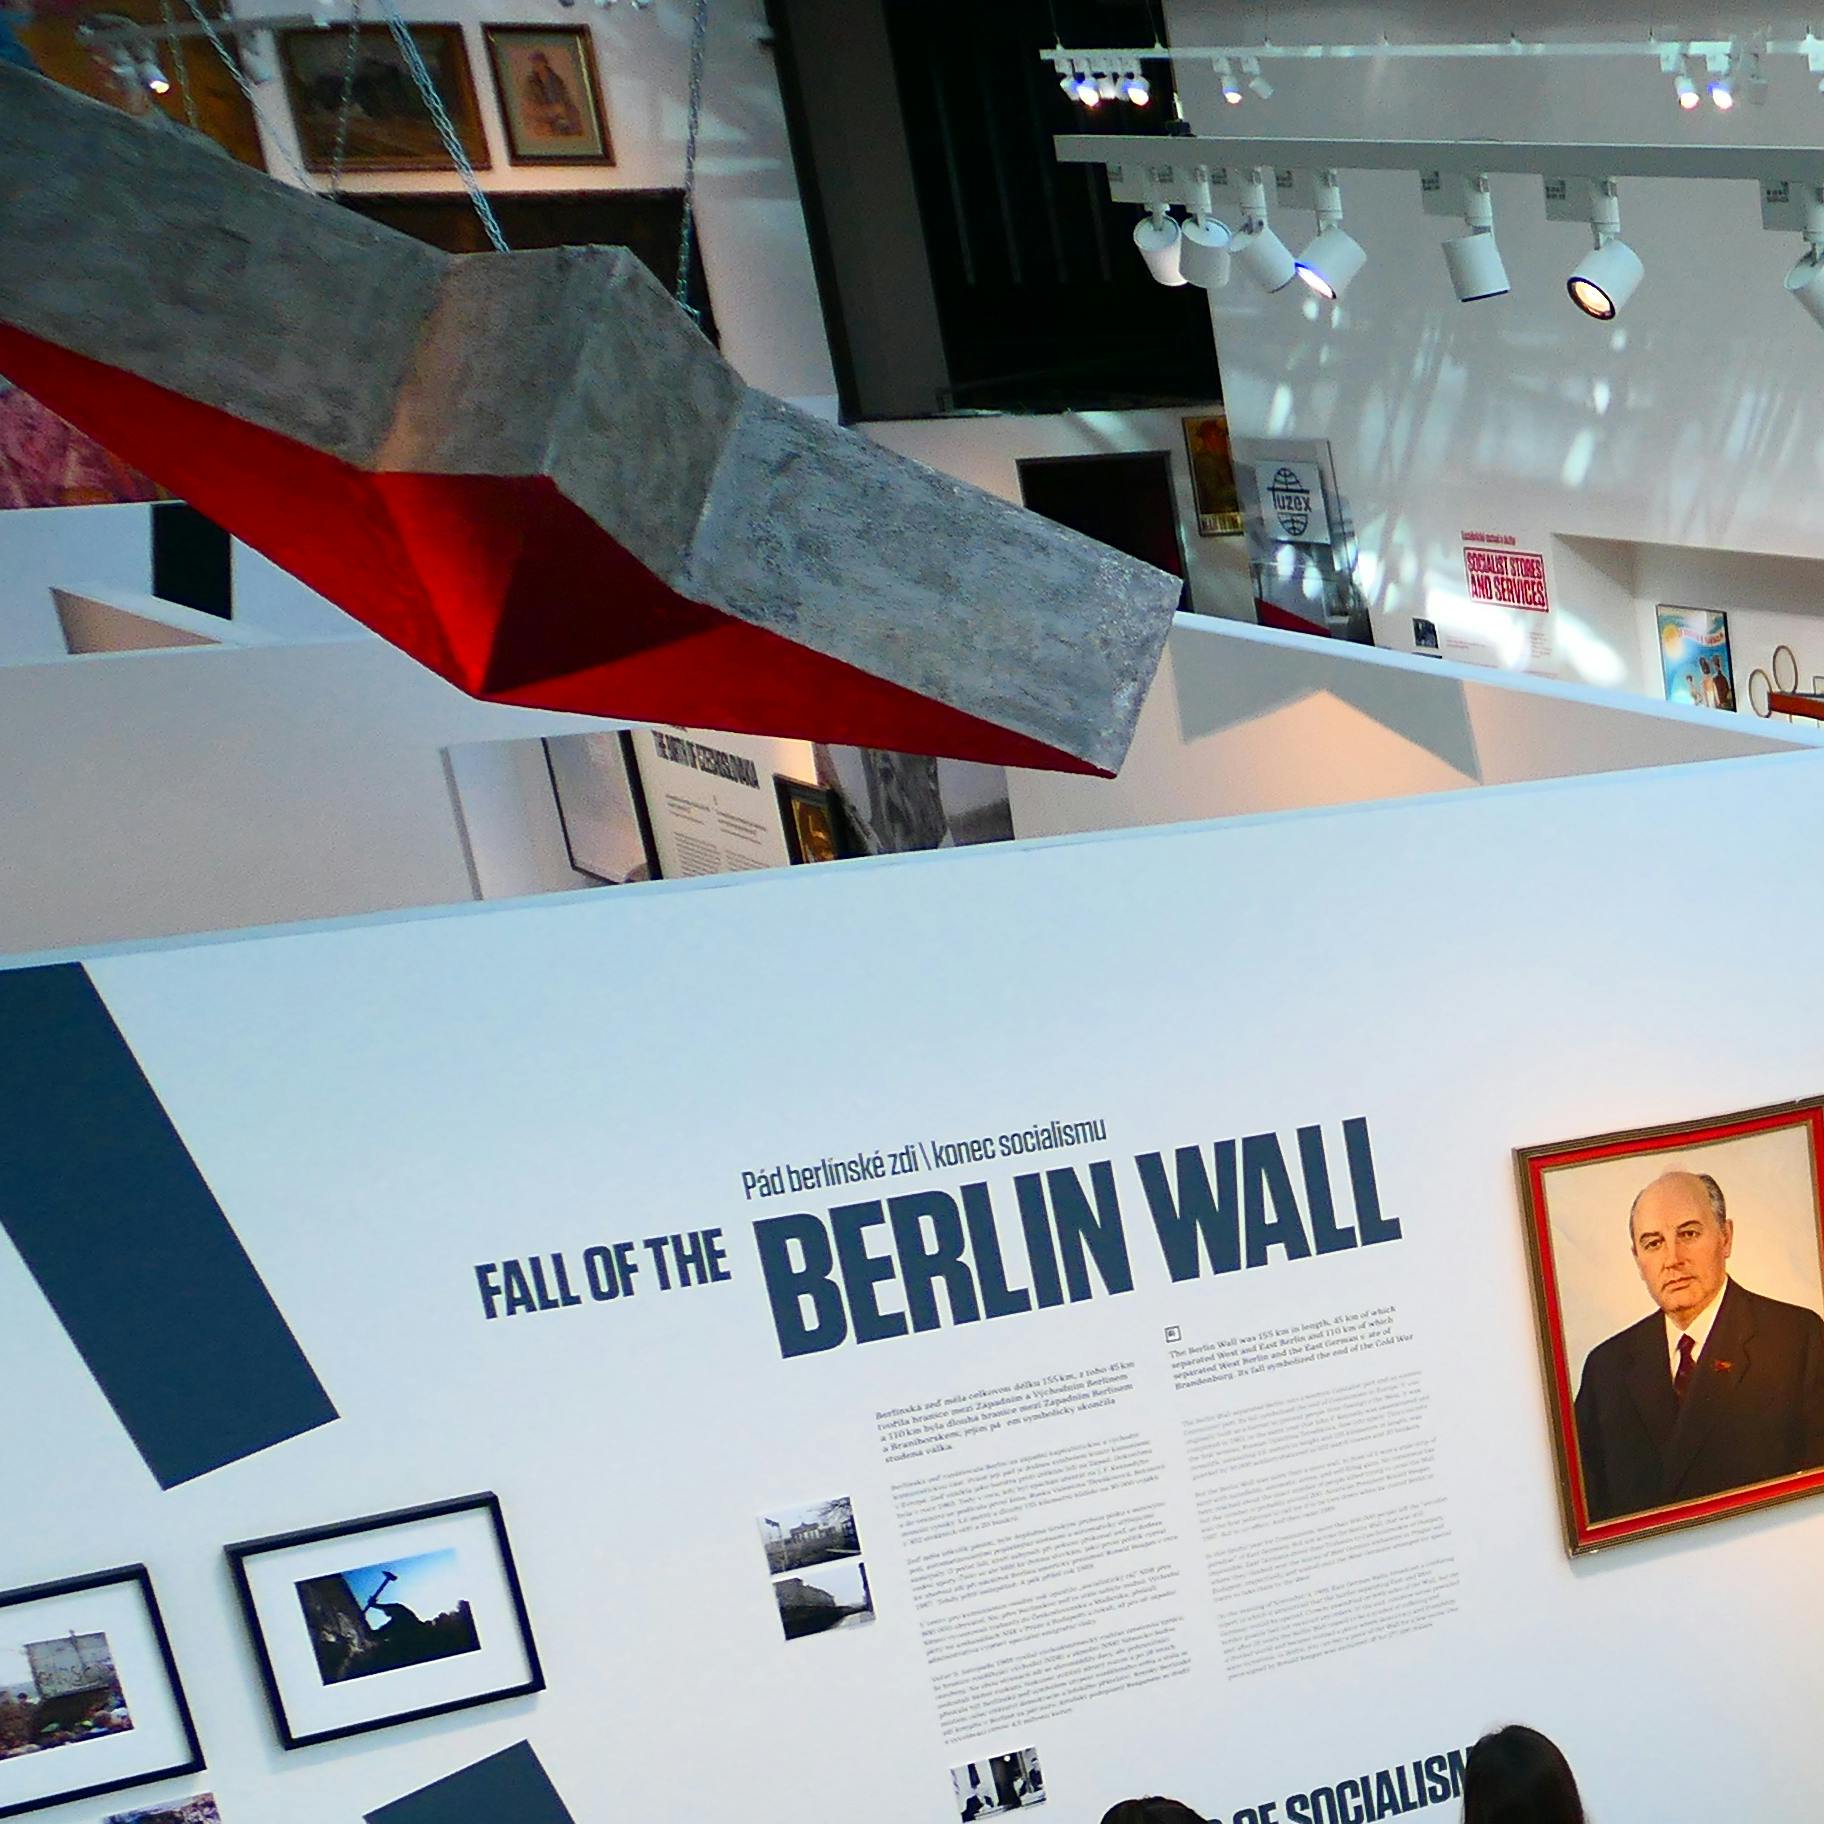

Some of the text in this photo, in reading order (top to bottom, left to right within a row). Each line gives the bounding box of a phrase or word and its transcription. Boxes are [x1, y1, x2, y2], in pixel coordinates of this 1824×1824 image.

[1467, 551, 1542, 579] SOCIALIST STORES
[1471, 574, 1545, 606] AND SERVICES
[741, 1166, 785, 1200] Pád
[788, 1150, 886, 1193] berlínské
[890, 1144, 920, 1175] zdi
[932, 1137, 996, 1168] konec
[1000, 1119, 1107, 1157] socialismu
[474, 1116, 1402, 1360] FALL OF THE BERLIN WALL
